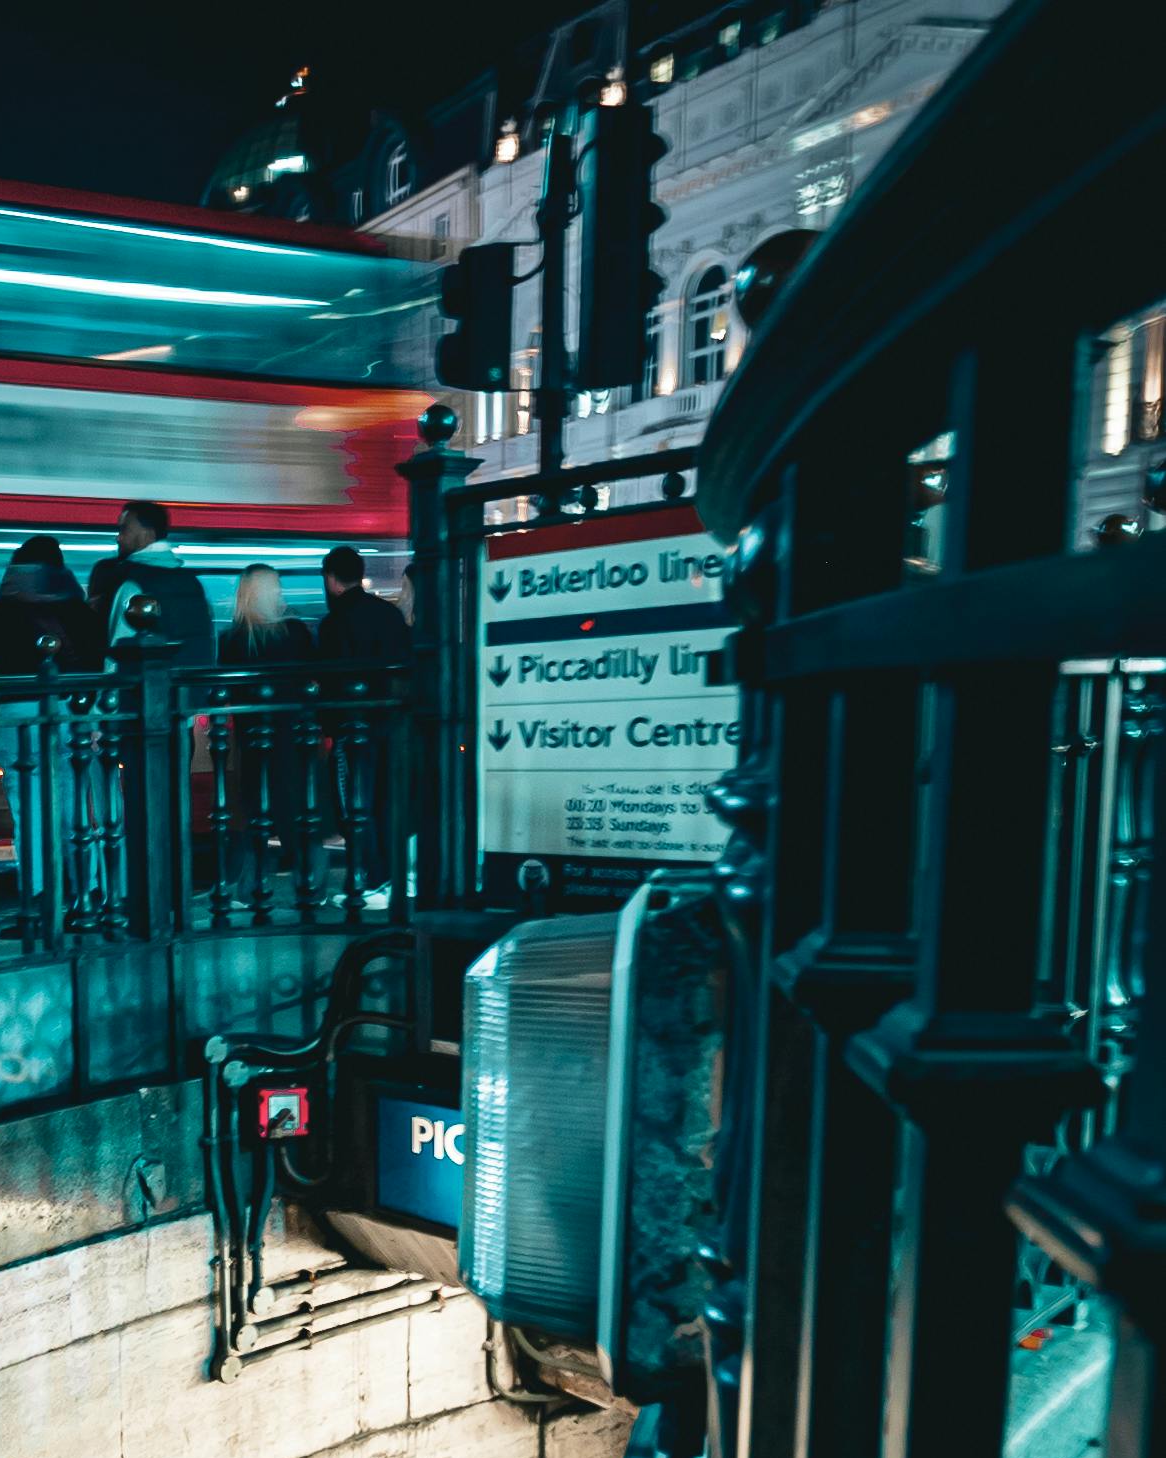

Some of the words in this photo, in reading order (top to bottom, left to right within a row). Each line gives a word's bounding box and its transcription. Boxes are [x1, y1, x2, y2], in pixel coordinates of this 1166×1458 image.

[518, 559, 649, 597] Bakerloo
[658, 550, 725, 583] line
[517, 648, 660, 685] Piccadilly
[517, 718, 616, 749] Visitor
[626, 716, 741, 748] Centre
[609, 817, 672, 835] Sundays
[411, 1116, 466, 1165] PIC
